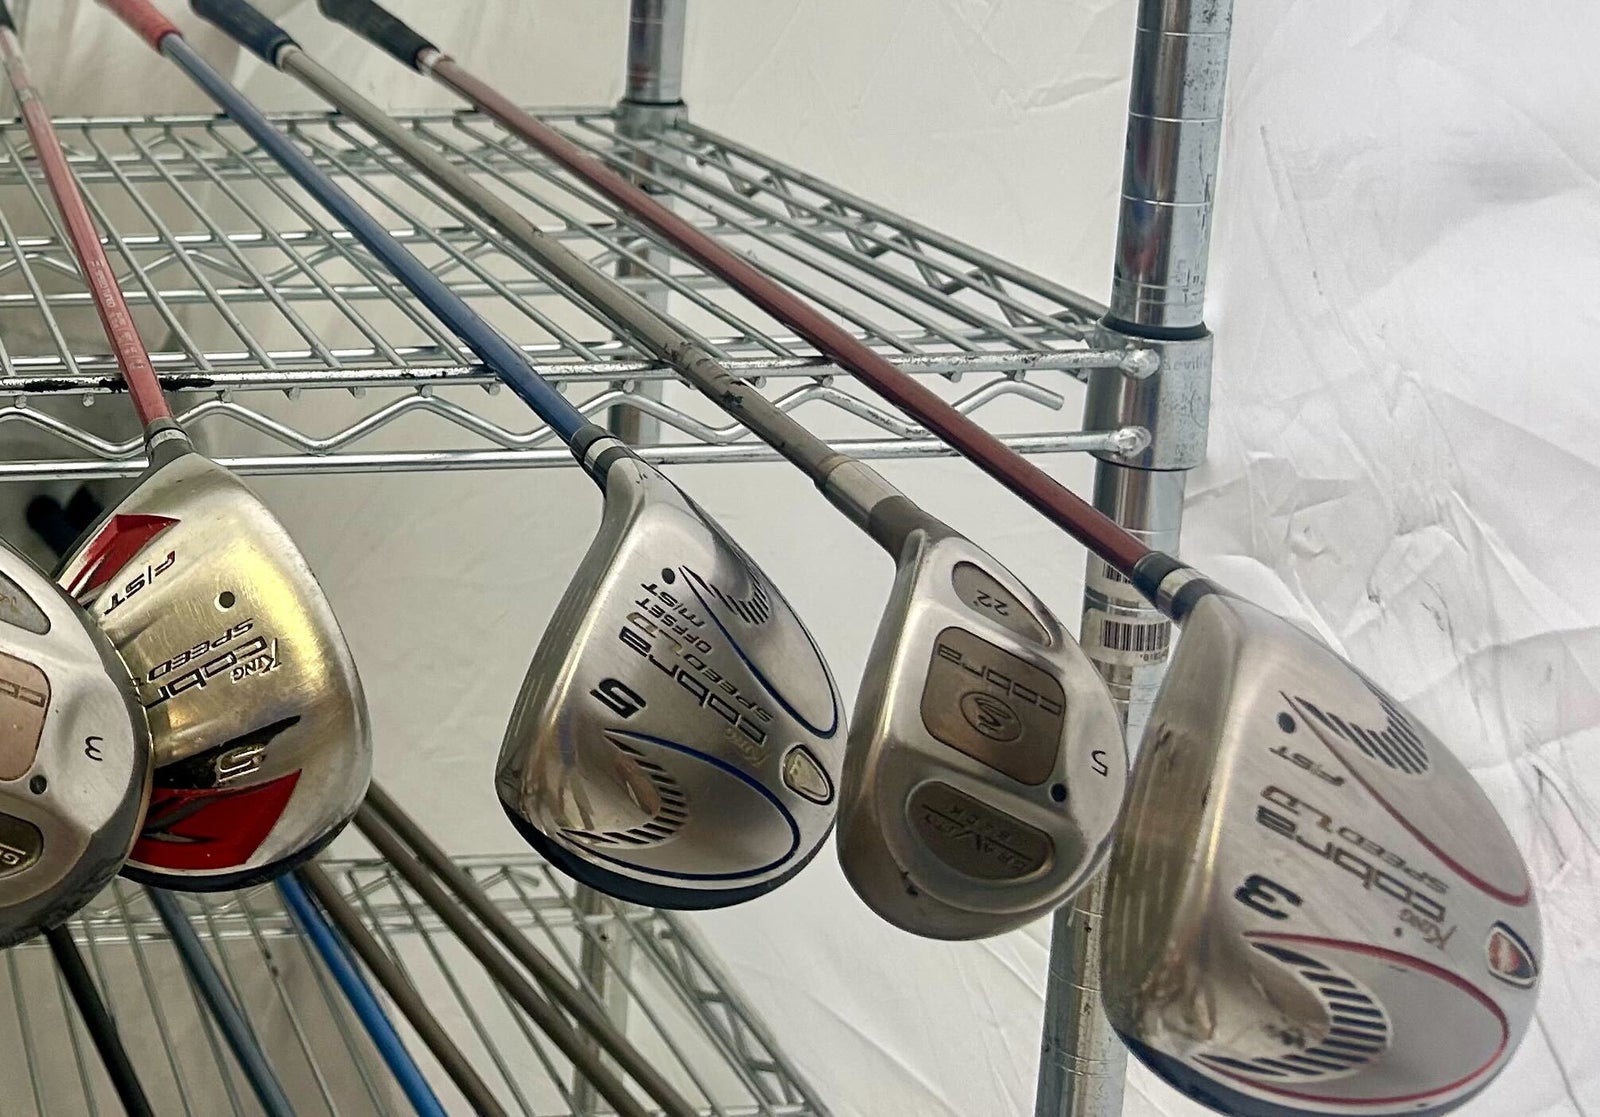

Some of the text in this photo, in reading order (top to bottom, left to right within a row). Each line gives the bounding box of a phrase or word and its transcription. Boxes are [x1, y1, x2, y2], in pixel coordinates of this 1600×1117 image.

[103, 550, 176, 615] F/ST
[147, 618, 255, 683] SPEED
[635, 598, 712, 654] OFFSET
[144, 636, 267, 709] cobr
[590, 678, 646, 719] 5
[619, 626, 767, 746] cobra
[938, 644, 1062, 718] cobra
[84, 736, 104, 762] 3
[217, 744, 266, 784] 5
[1091, 750, 1108, 777] 5
[922, 813, 1027, 872] GRAVITY
[950, 805, 1012, 841] BACK
[1256, 806, 1446, 926] cobra
[1234, 873, 1303, 920] 3
